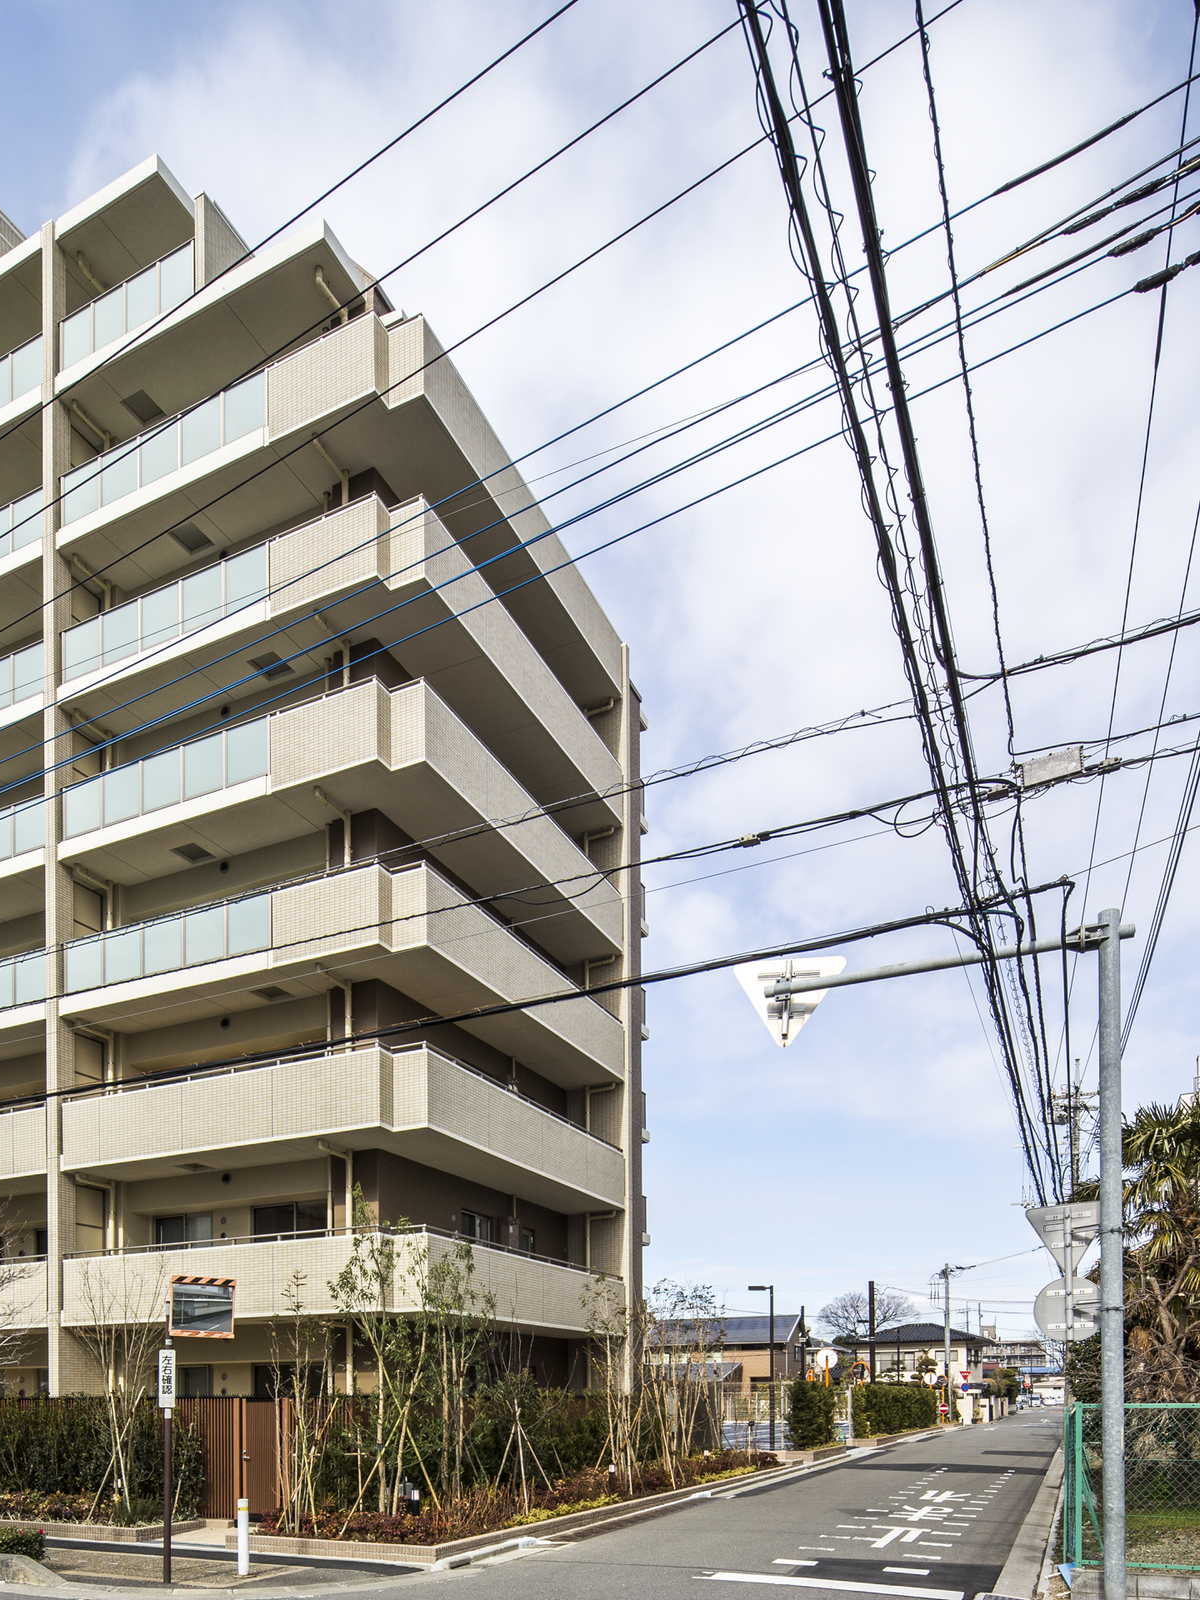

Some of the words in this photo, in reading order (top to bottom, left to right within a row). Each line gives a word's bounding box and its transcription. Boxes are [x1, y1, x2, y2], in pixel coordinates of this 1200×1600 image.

[161, 1355, 173, 1395] 左右確認
[870, 1490, 971, 1548] 止まれ
